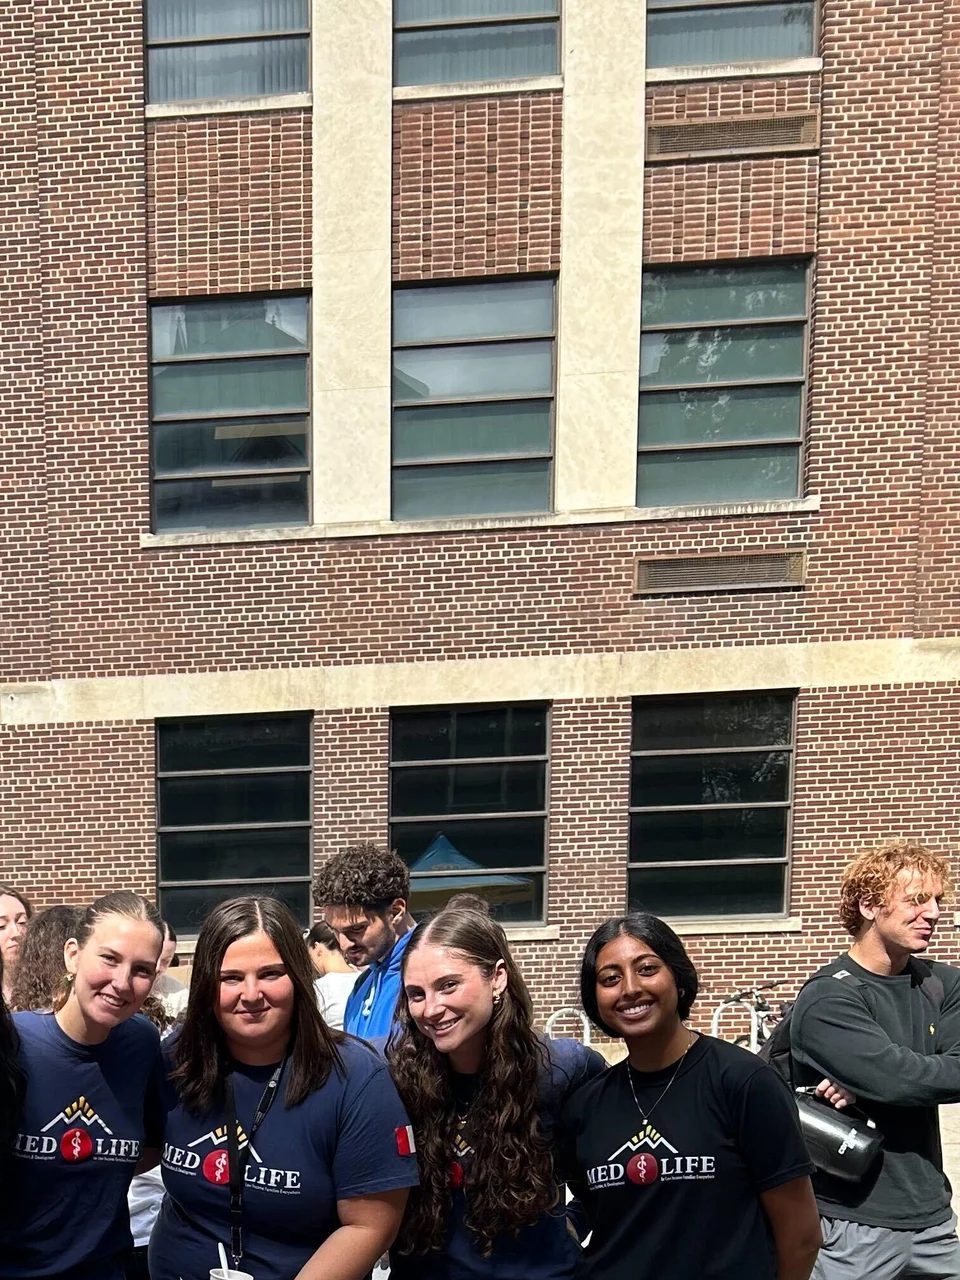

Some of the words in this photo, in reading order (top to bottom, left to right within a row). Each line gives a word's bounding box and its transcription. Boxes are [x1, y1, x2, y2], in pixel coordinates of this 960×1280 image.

[94, 1138, 140, 1158] LIFE
[243, 1164, 301, 1189] LIFE
[586, 1163, 625, 1186] MED
[660, 1156, 716, 1176] LIFE
